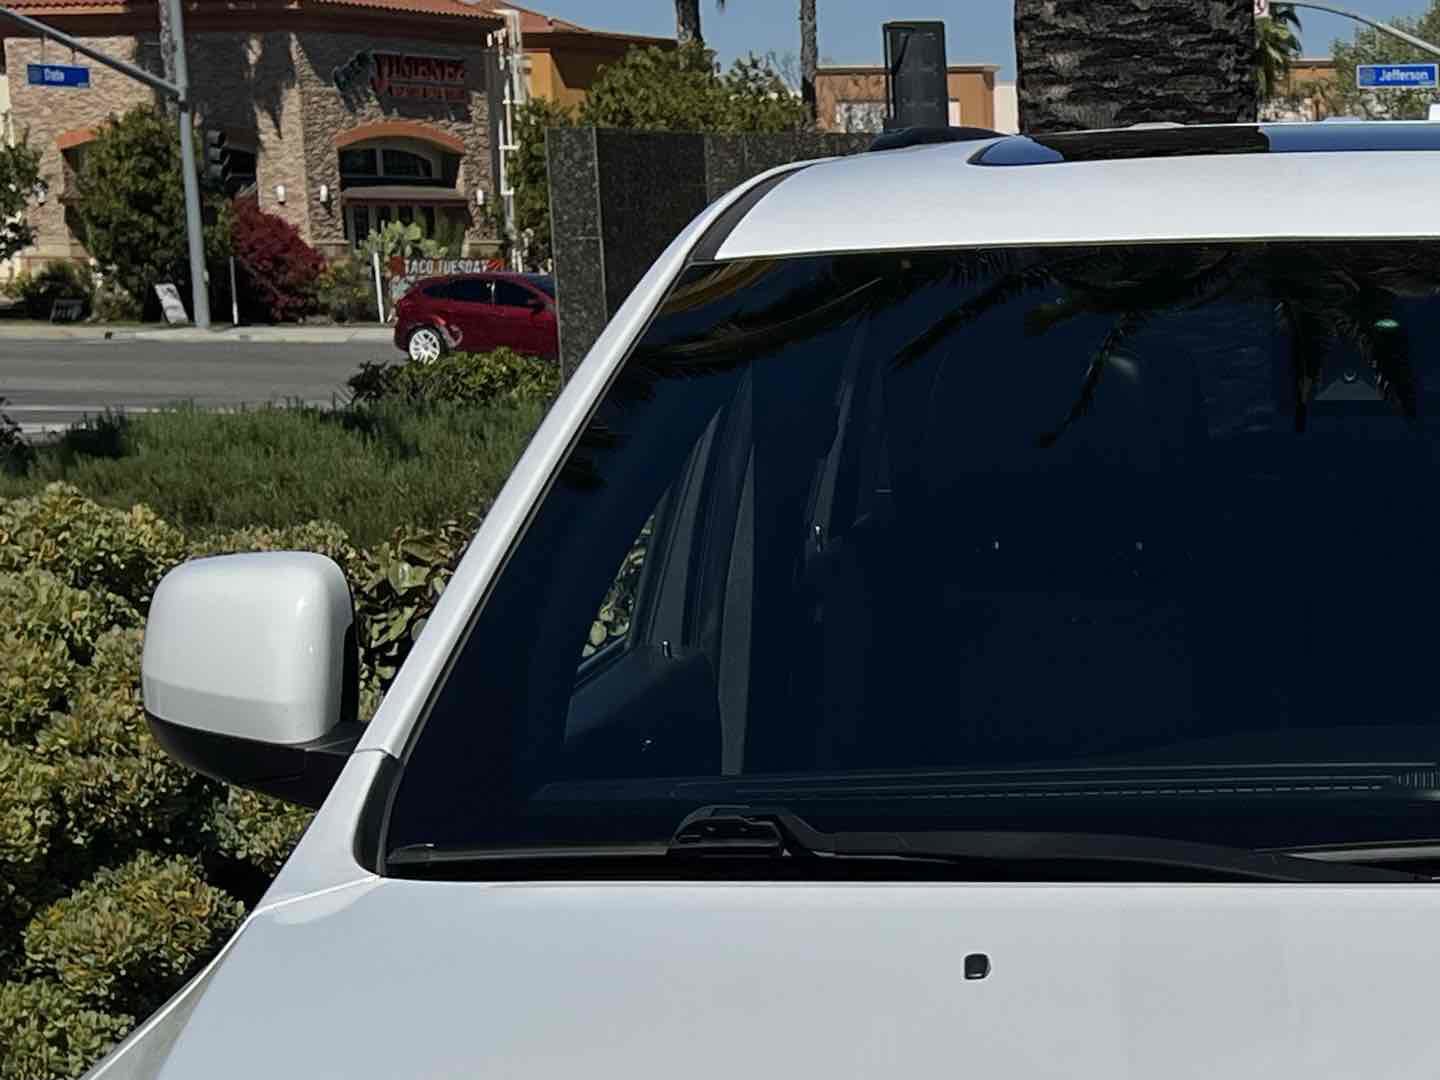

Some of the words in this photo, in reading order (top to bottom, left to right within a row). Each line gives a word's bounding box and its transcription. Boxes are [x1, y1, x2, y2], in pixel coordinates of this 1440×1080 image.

[1379, 69, 1429, 81] Jefferson
[404, 259, 433, 273] TACO
[438, 259, 488, 274] TUESDAY
